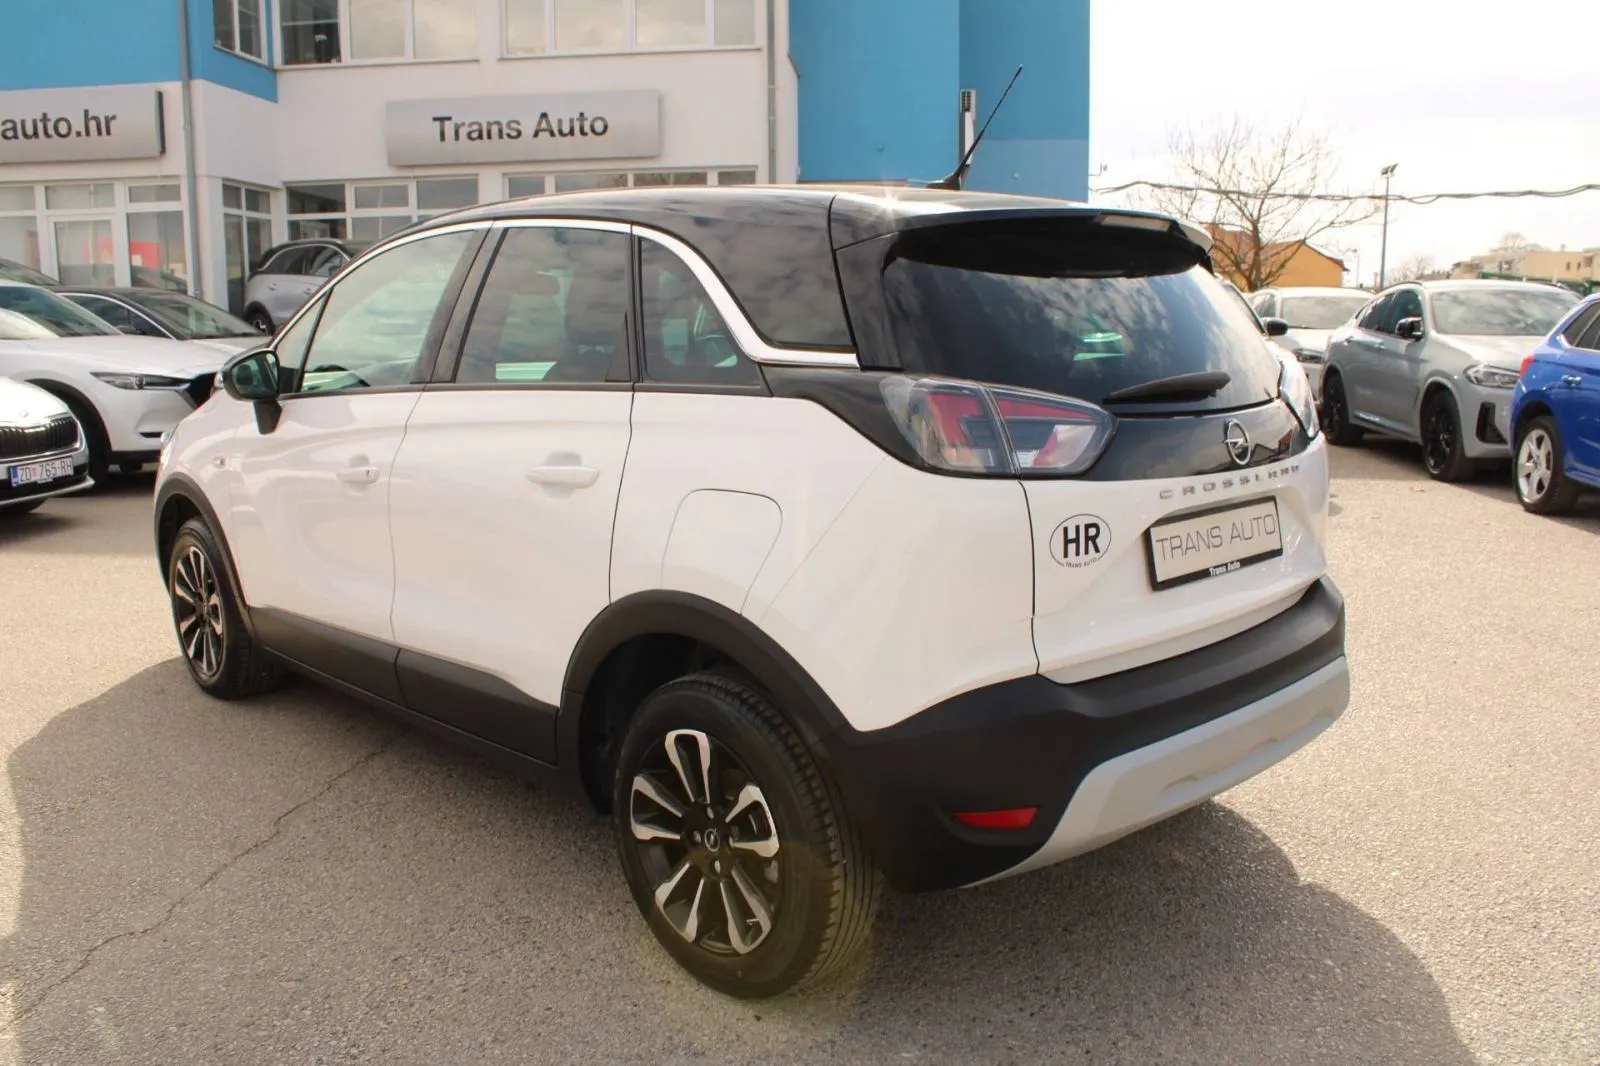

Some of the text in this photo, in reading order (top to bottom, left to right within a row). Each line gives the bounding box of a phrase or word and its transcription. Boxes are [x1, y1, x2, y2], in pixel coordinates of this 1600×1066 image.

[432, 111, 609, 142] Trans Auto
[1063, 522, 1101, 559] HR
[1156, 513, 1276, 561] TRANS AUTO
